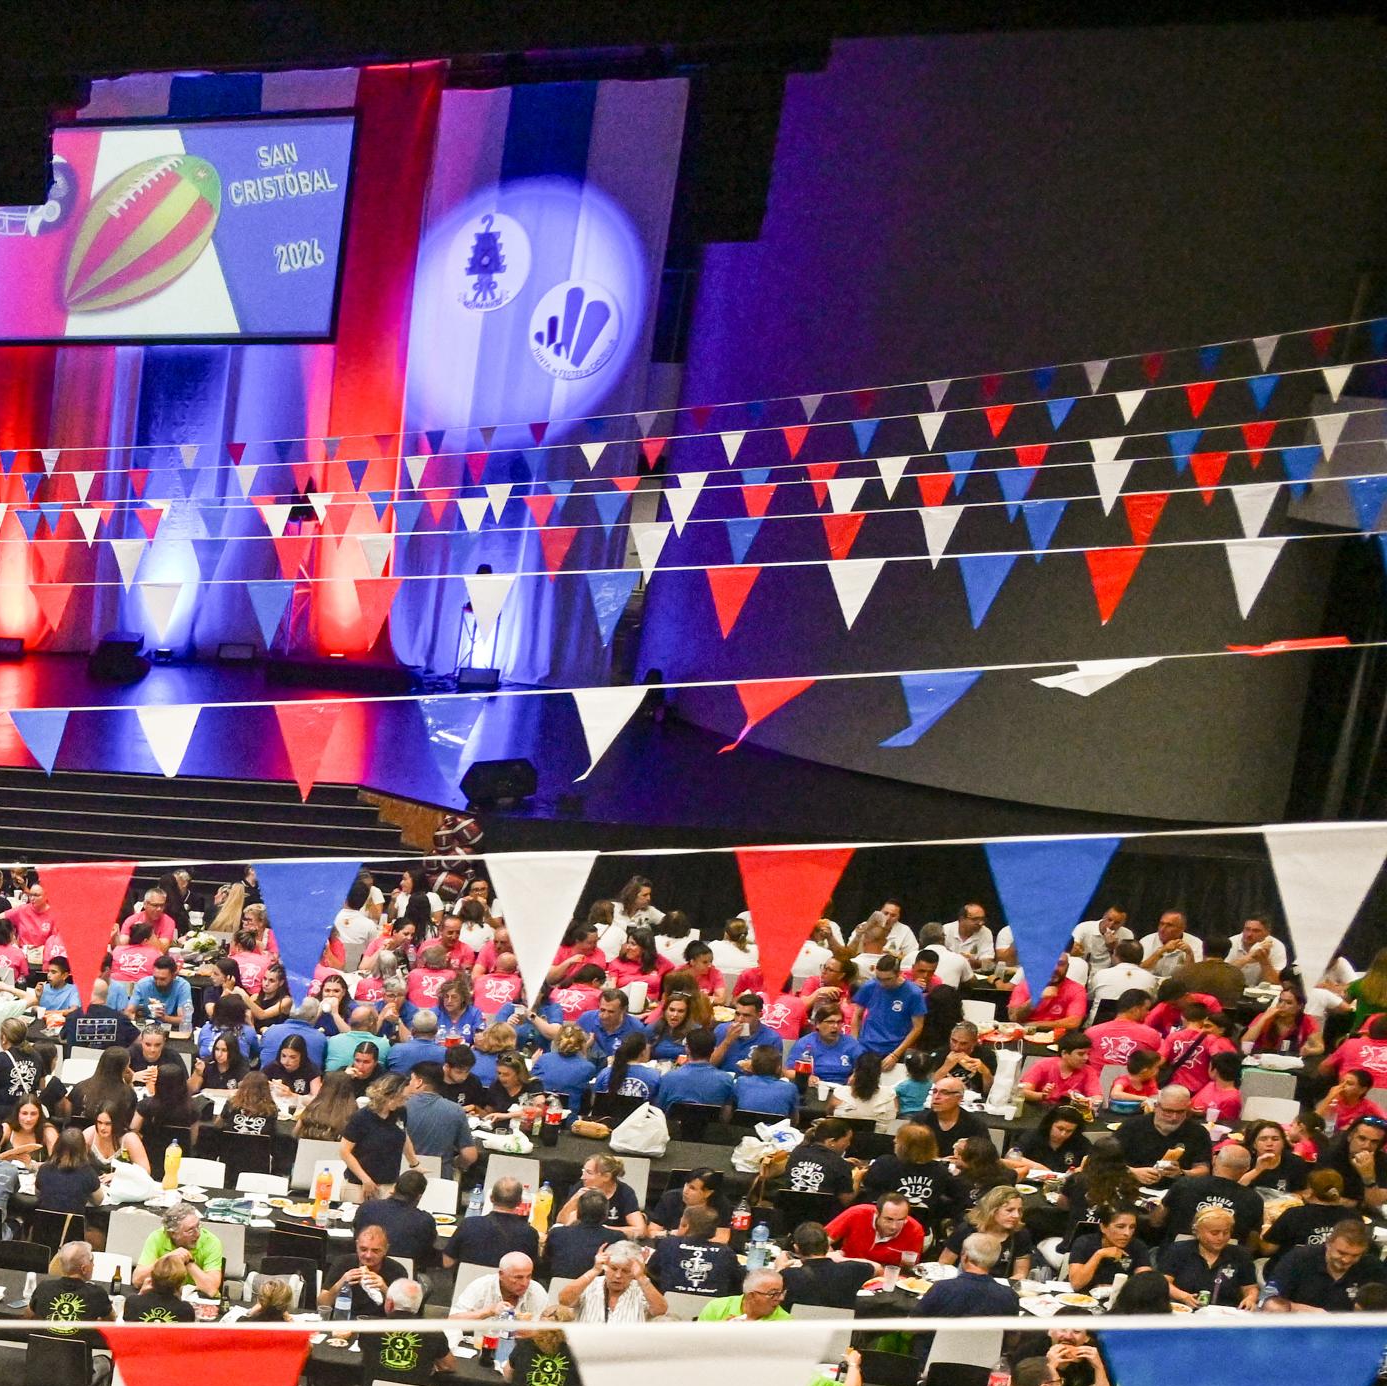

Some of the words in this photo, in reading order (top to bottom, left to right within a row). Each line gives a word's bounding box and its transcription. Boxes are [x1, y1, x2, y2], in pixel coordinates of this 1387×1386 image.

[257, 142, 298, 168] SAN
[228, 166, 339, 207] CRISTÓBAL
[274, 238, 325, 272] 2026
[798, 1161, 823, 1171] GAIATA
[900, 1176, 933, 1186] GAIATA
[911, 1185, 922, 1194] 12
[1206, 1196, 1234, 1207] GAIATA
[679, 1243, 708, 1252] Gaiata
[60, 1303, 70, 1314] 3
[395, 1339, 405, 1349] 3
[544, 1363, 553, 1372] 3
